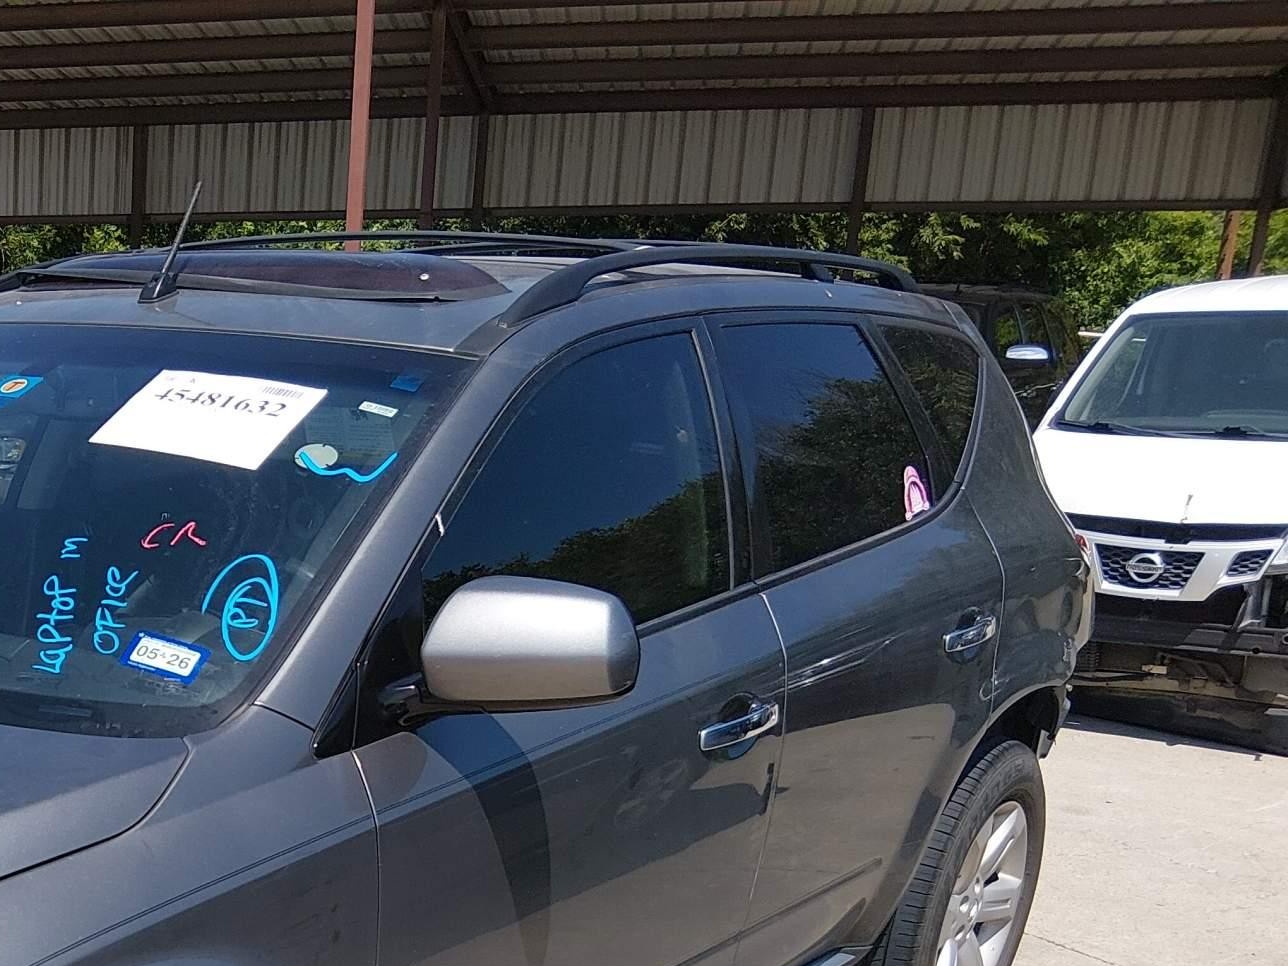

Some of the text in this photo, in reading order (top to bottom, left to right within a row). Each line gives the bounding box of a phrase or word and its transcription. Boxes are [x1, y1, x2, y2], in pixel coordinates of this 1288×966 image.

[154, 387, 288, 418] 45481632
[136, 645, 160, 660] 05
[166, 653, 191, 670] 26
